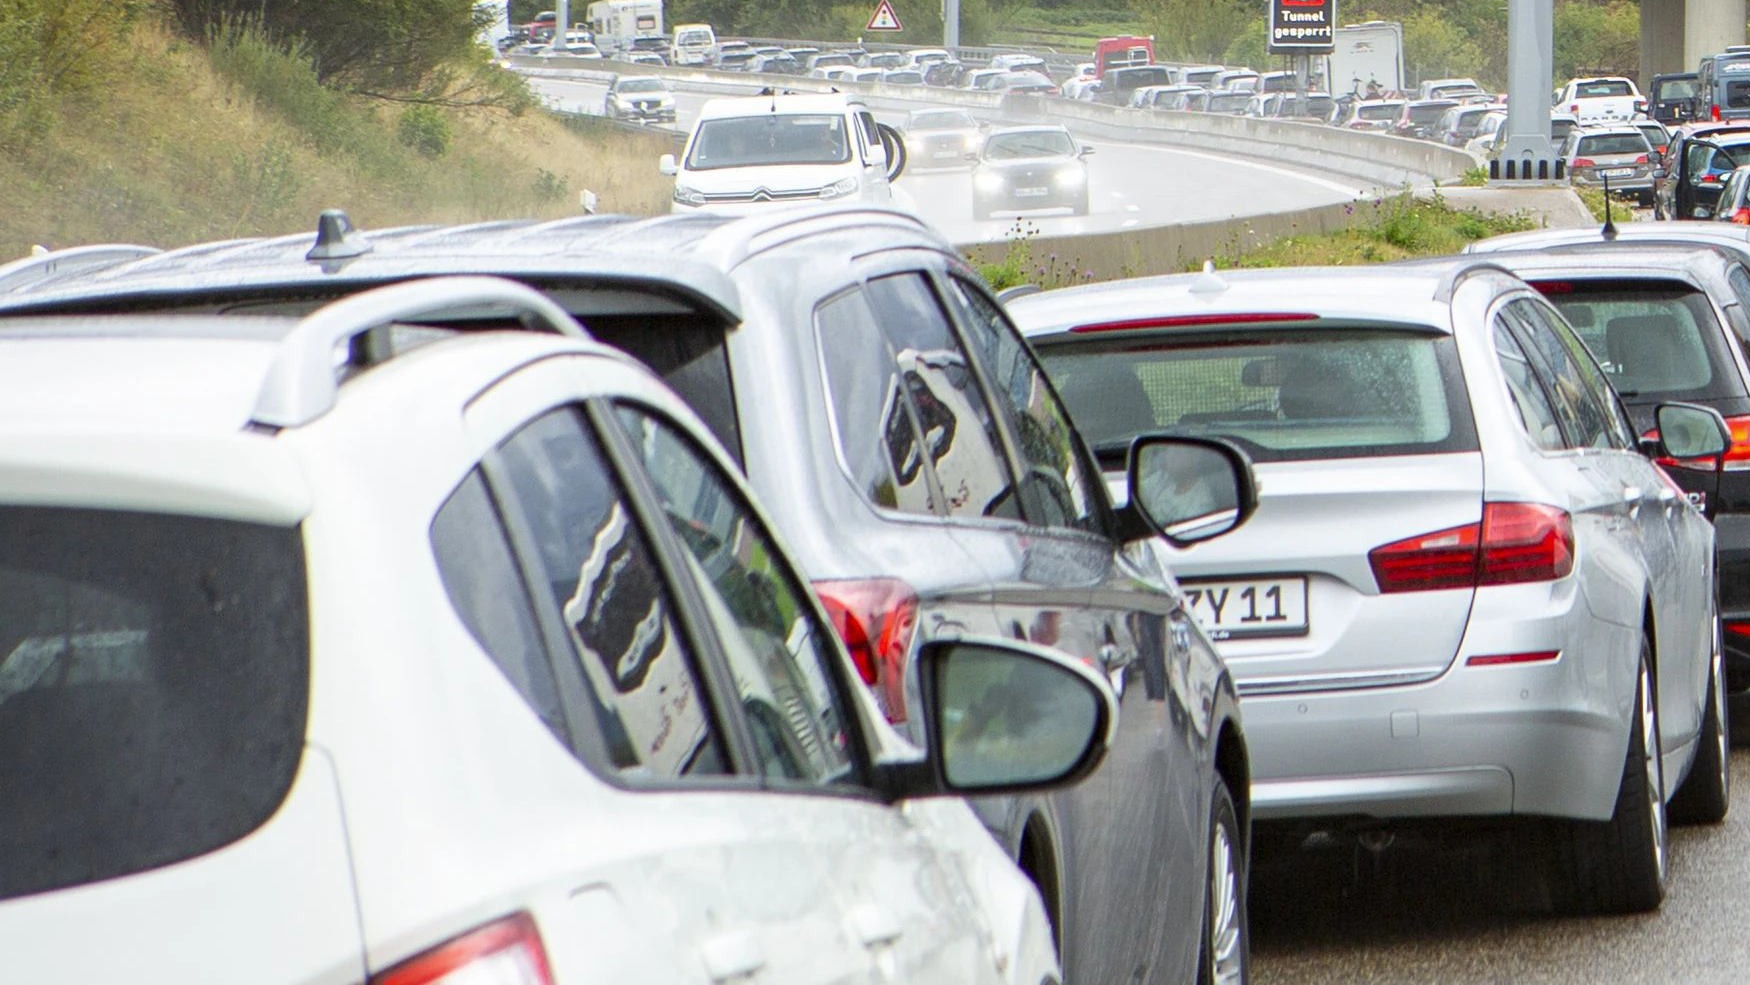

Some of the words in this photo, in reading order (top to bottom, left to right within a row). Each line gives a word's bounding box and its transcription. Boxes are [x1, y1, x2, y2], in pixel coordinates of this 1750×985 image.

[1281, 11, 1325, 22] Tunnel
[1275, 26, 1331, 38] gesperrt
[1241, 585, 1287, 622] 11
